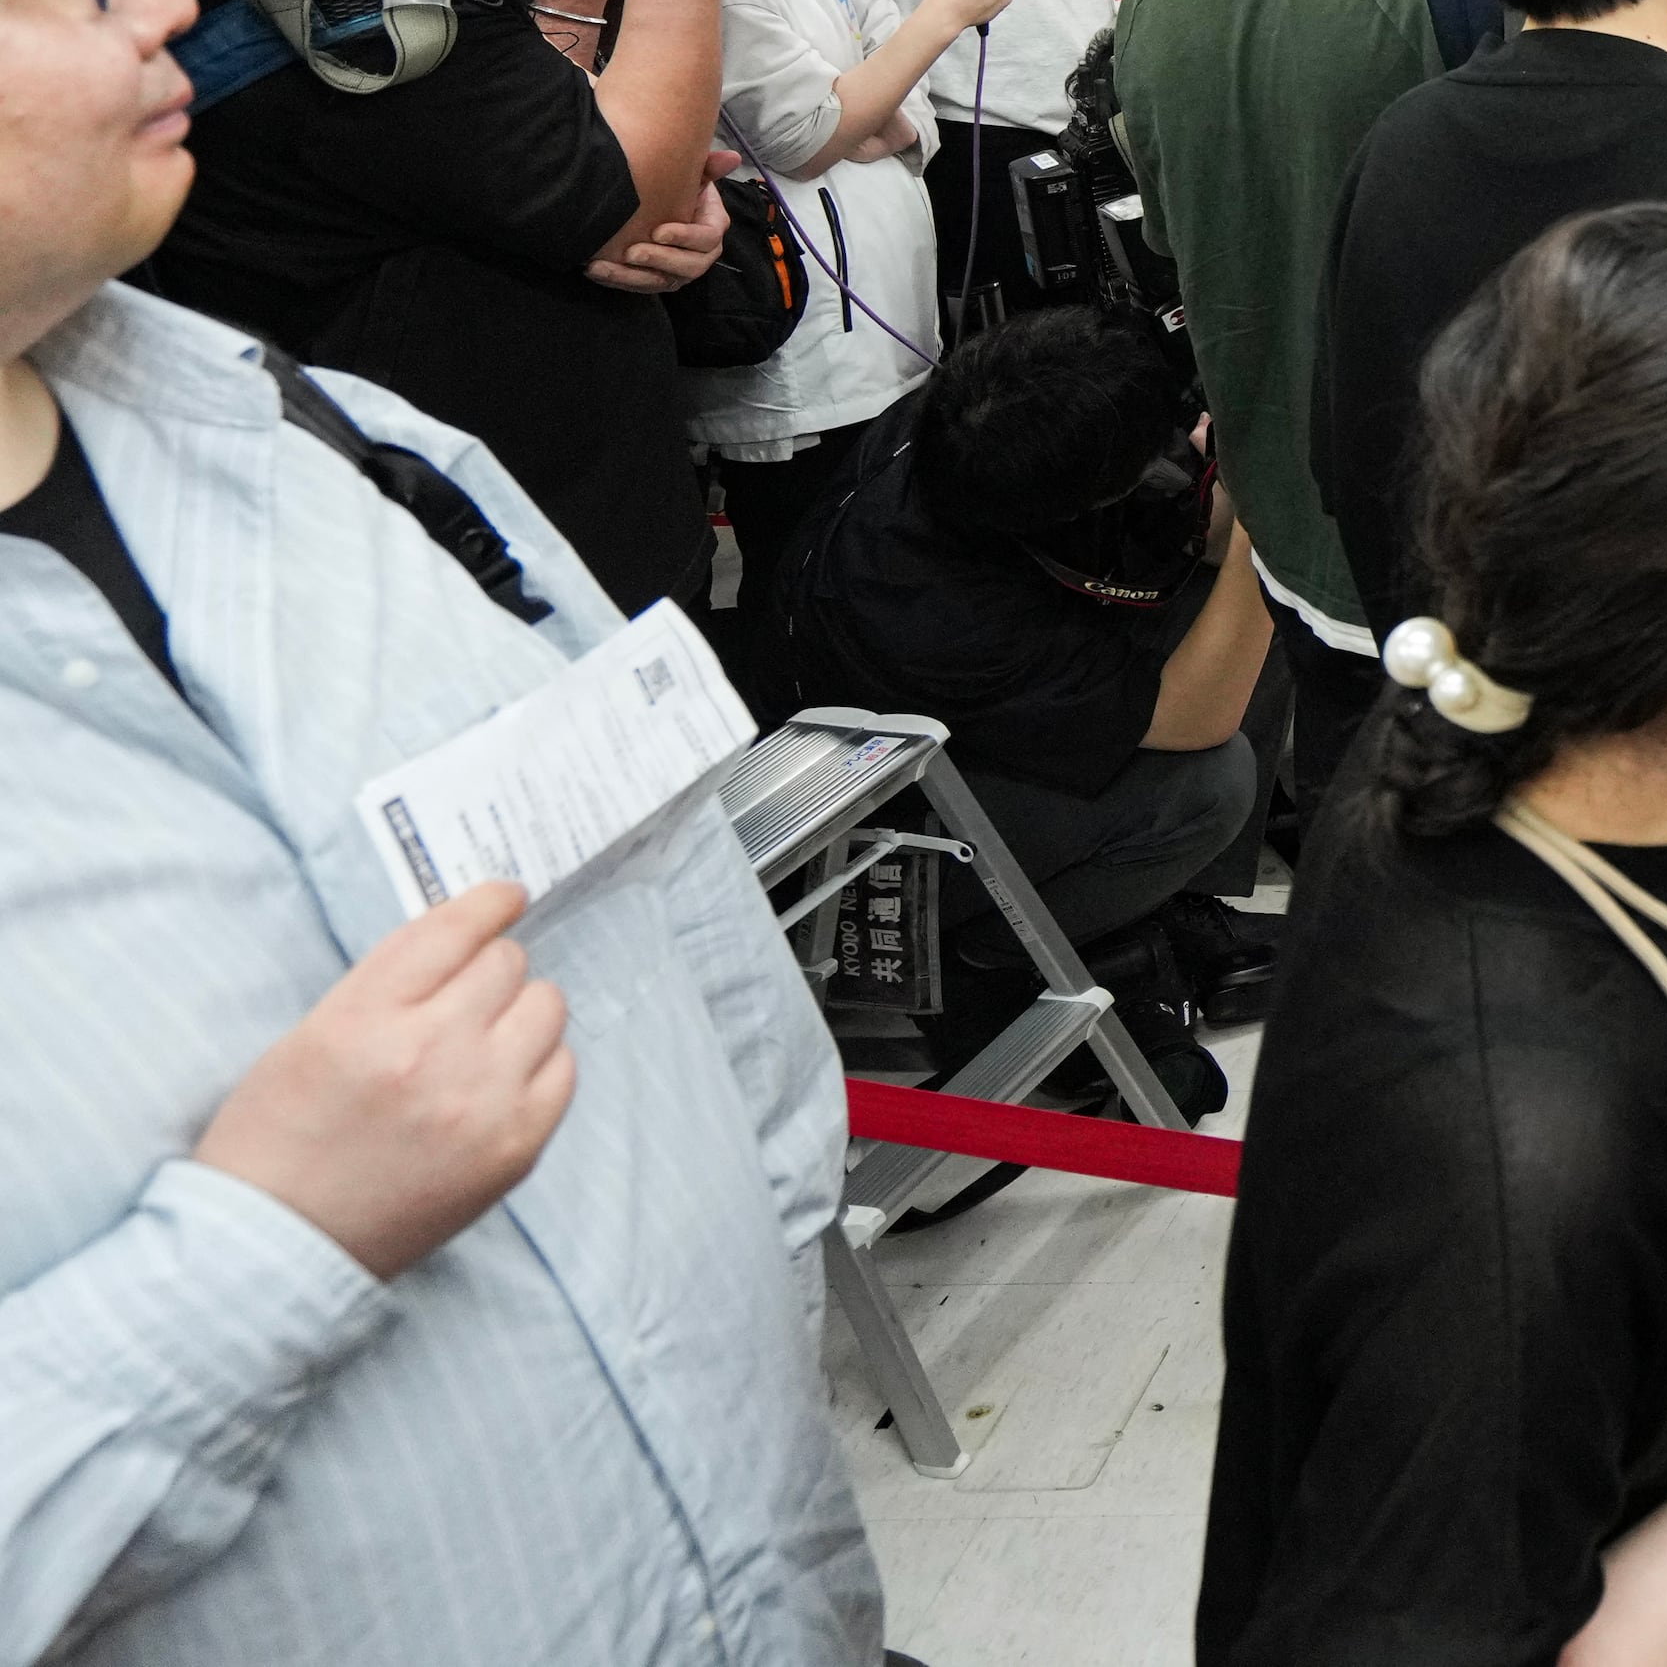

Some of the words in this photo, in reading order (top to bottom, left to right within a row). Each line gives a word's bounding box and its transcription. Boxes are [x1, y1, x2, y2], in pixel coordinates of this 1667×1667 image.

[1084, 581, 1160, 601] Canon
[839, 919, 861, 978] KYODO
[867, 863, 904, 984] 共同通信
